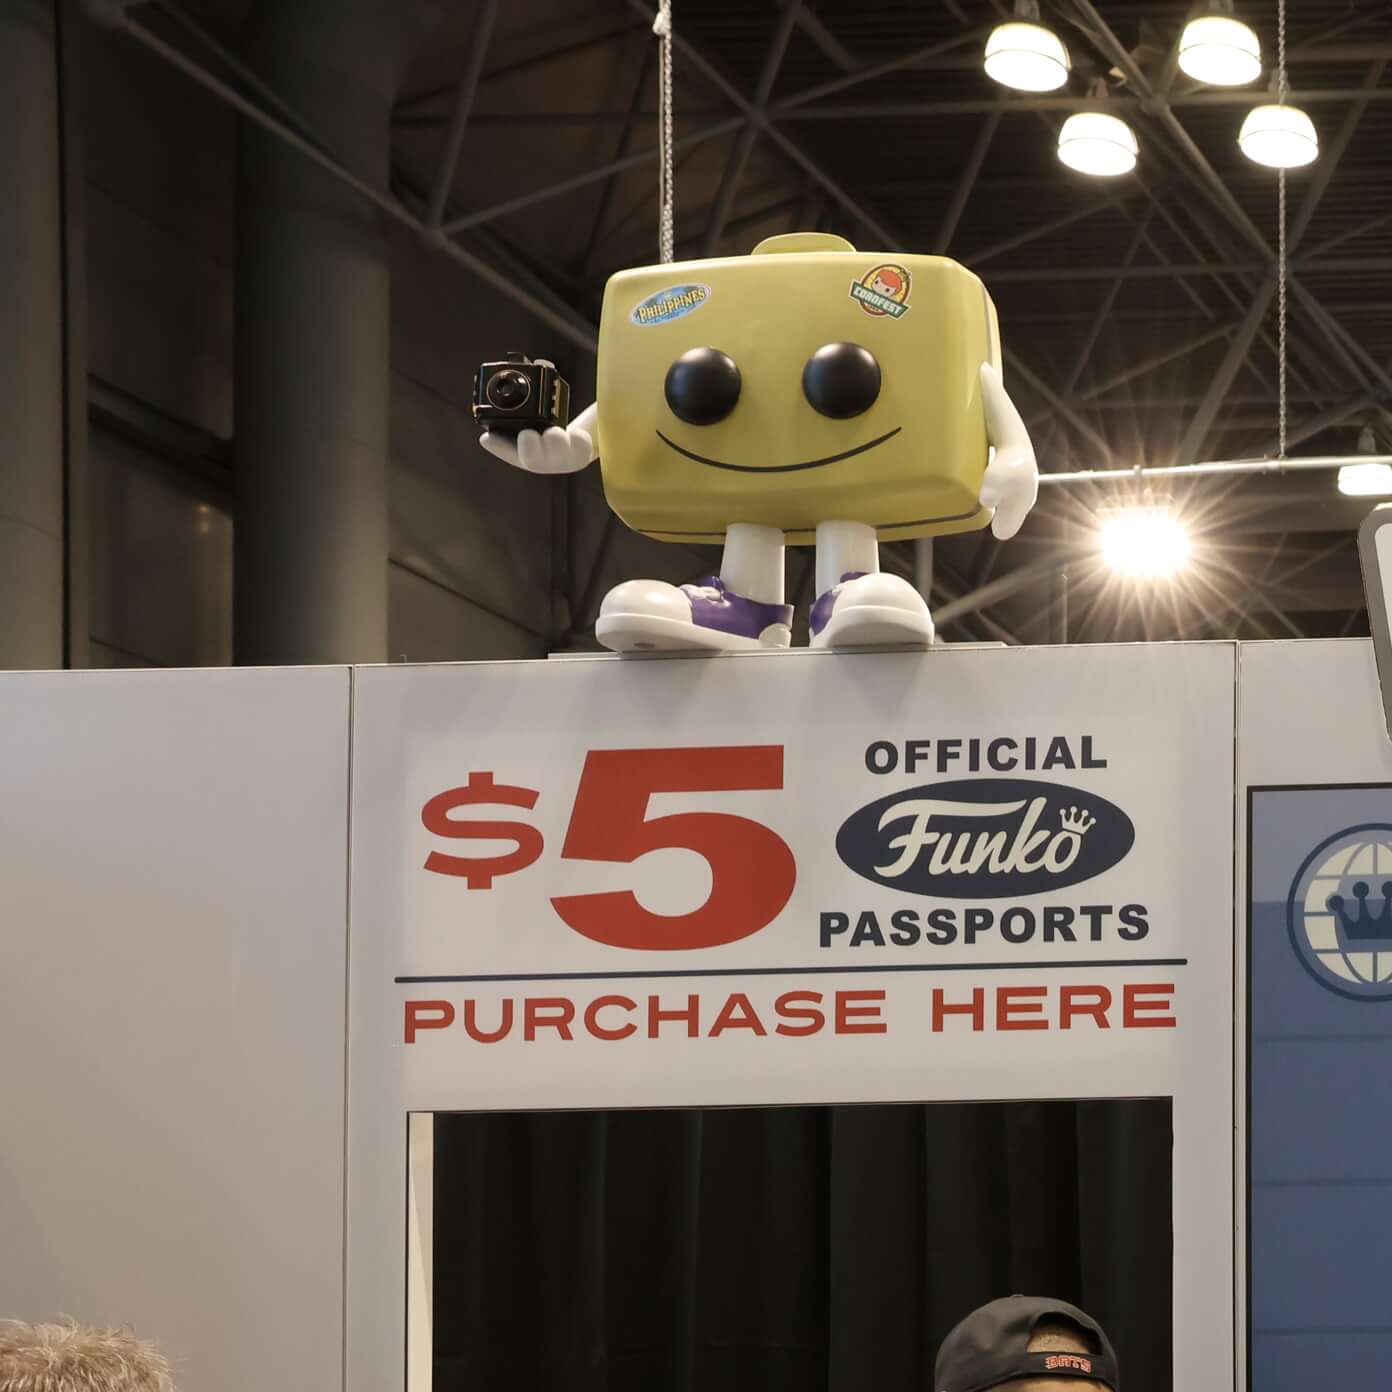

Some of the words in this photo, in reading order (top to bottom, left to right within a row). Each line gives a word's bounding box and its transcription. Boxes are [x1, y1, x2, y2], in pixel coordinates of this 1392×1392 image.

[638, 287, 707, 324] PHILIPPINES
[864, 735, 1108, 775] OFFICIAL
[420, 744, 797, 951] $5
[871, 796, 1092, 879] Funko
[818, 903, 1151, 949] PASSPORTS
[403, 990, 889, 1045] PURCHASE
[930, 983, 1179, 1034] HERE
